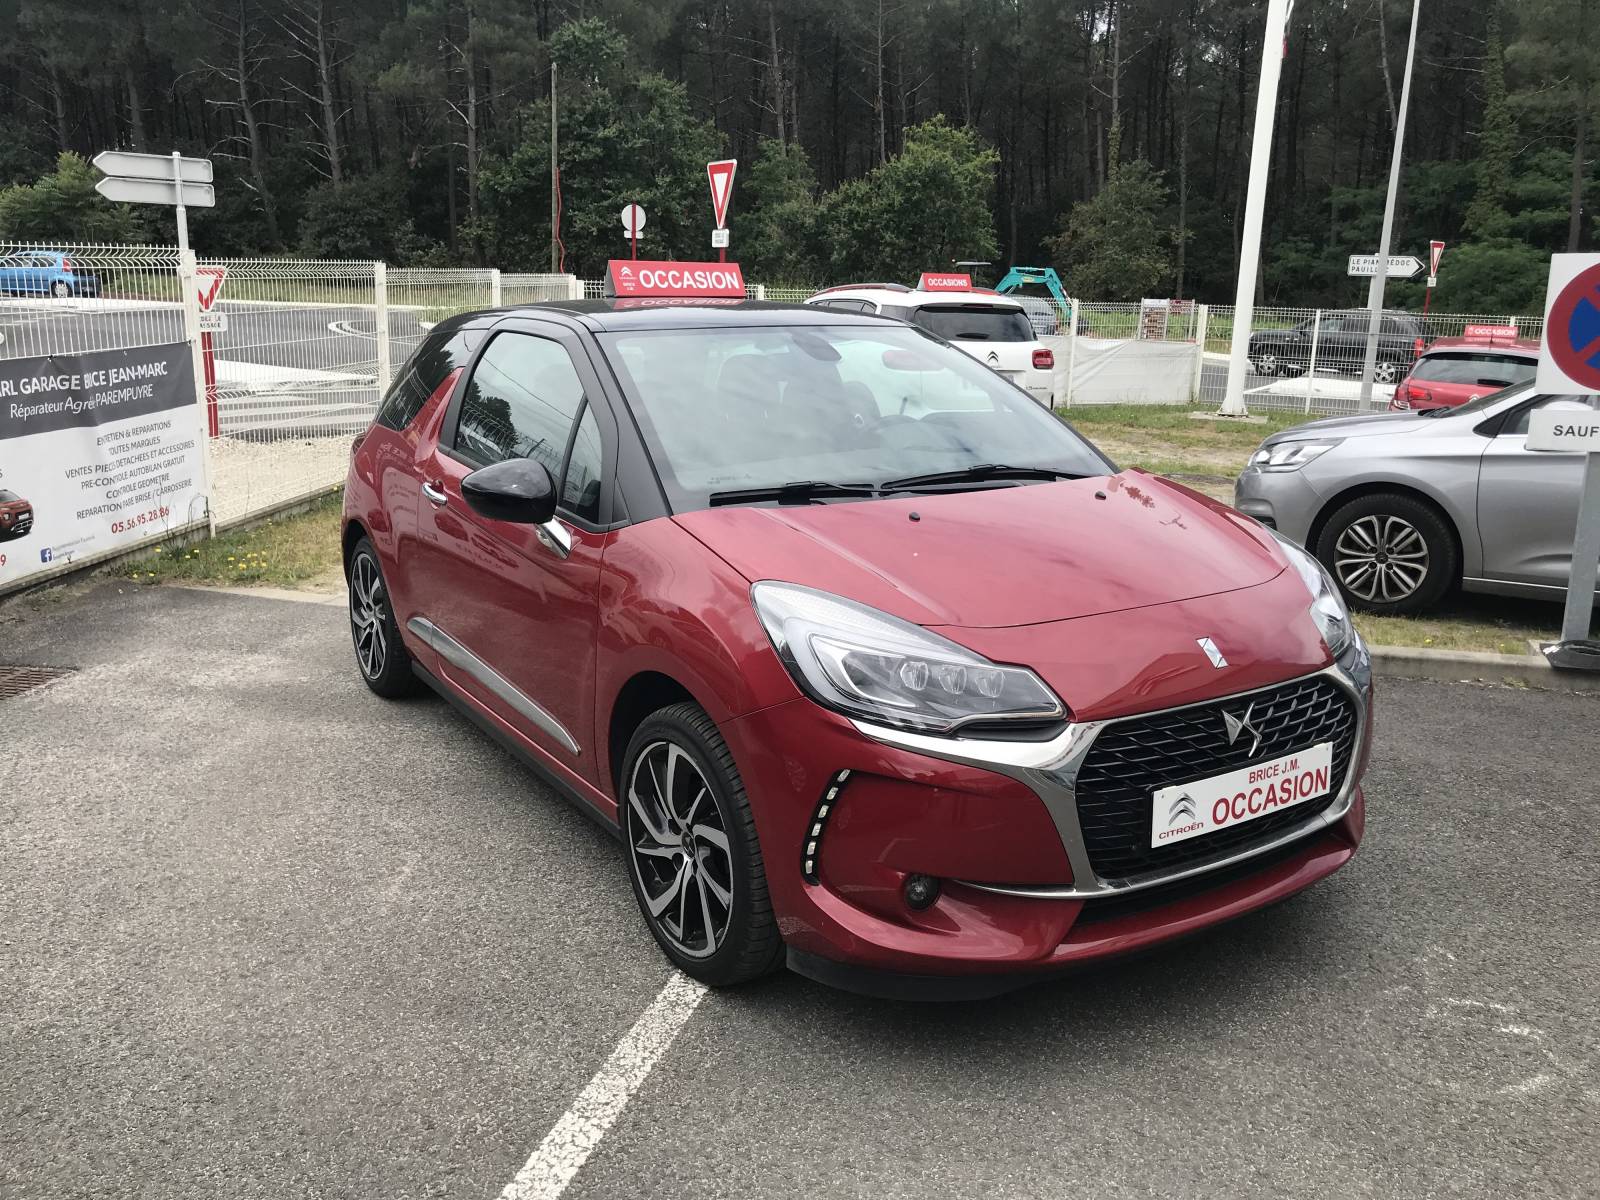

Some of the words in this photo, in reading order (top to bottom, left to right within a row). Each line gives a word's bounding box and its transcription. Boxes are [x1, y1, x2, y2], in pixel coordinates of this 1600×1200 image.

[639, 270, 739, 289] OCCASION
[928, 278, 968, 287] OCCASIONS
[1474, 328, 1515, 336] OCCASION
[0, 379, 18, 397] RL
[20, 375, 81, 394] GARAGE
[108, 361, 168, 387] JEAN-MARC
[10, 402, 63, 421] Réparateur
[95, 384, 153, 407] PAREMPUYRE
[125, 430, 131, 438] &
[131, 420, 171, 435] REPARATIONS
[1553, 424, 1600, 437] SAUF
[131, 436, 160, 450] MARQUES
[65, 465, 92, 479] VENTES
[150, 449, 157, 458] ET
[157, 440, 195, 456] ACCESSOIRES
[129, 461, 162, 478] AUTOBILAN
[162, 455, 185, 468] GRATUIT
[138, 473, 170, 489] GEOMETRIE
[76, 502, 122, 520] REPARATION
[135, 491, 151, 504] BRISE
[156, 478, 192, 496] CARROSSERIE
[1249, 763, 1279, 784] BRICE
[1281, 758, 1300, 774] J.M.
[1212, 765, 1328, 826] OCCASION
